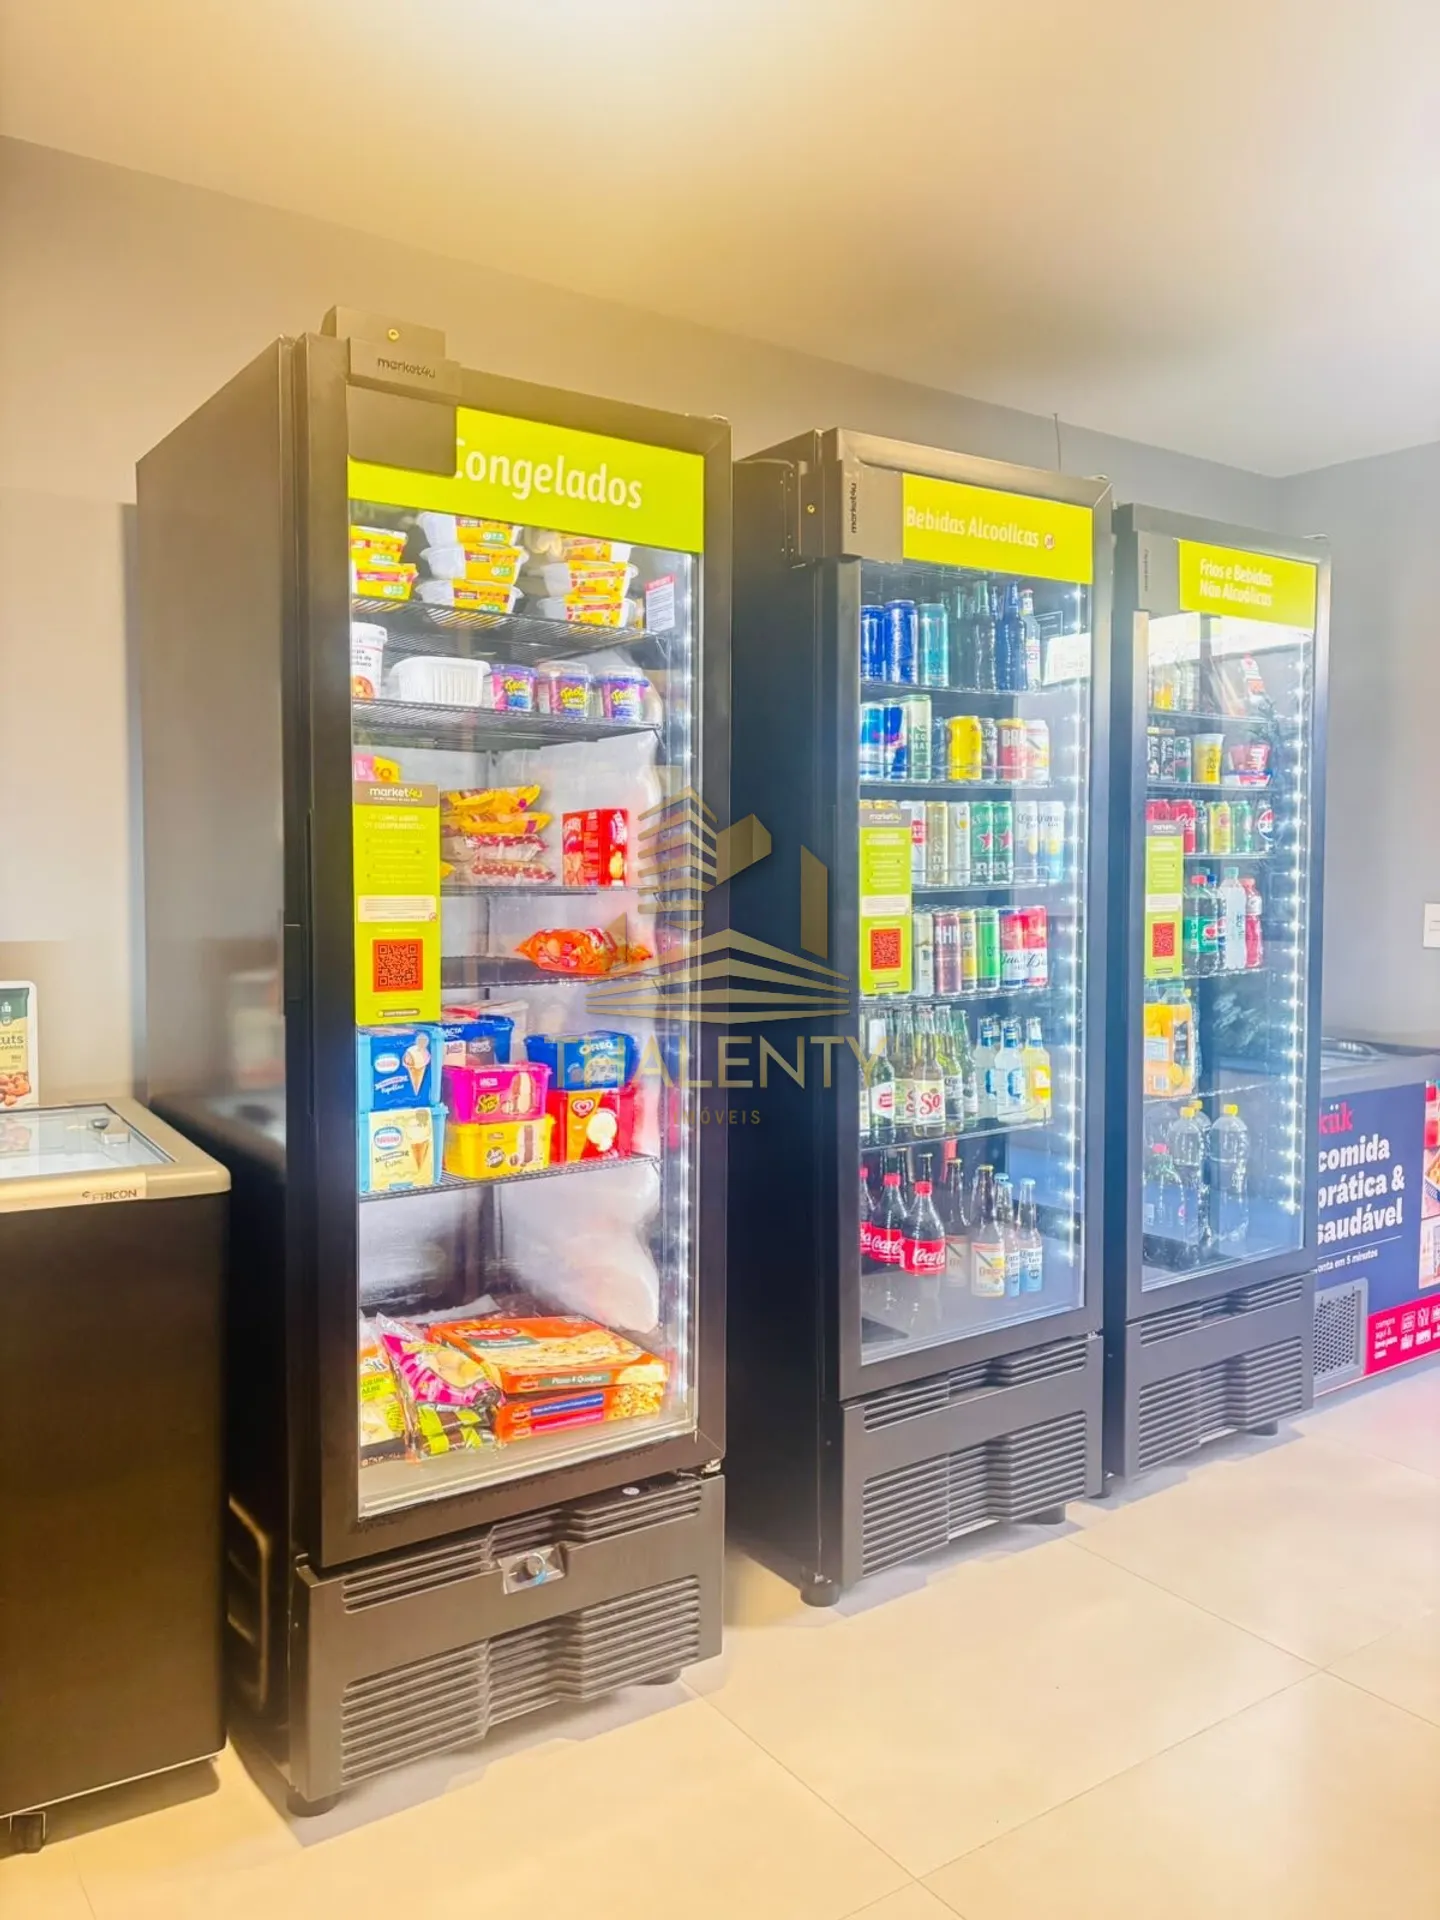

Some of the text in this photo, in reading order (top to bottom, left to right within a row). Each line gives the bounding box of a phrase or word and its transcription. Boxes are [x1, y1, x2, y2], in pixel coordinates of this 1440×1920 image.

[377, 357, 436, 379] market4u
[905, 505, 965, 535] Bebidas
[968, 515, 1039, 548] Alcoólicas
[1200, 557, 1273, 586] Frios e Bebidas
[1199, 578, 1221, 598] Não
[369, 787, 423, 798] market4u
[1318, 1133, 1390, 1173] comida
[1391, 1164, 1405, 1191] &
[1317, 1258, 1334, 1273] onta
